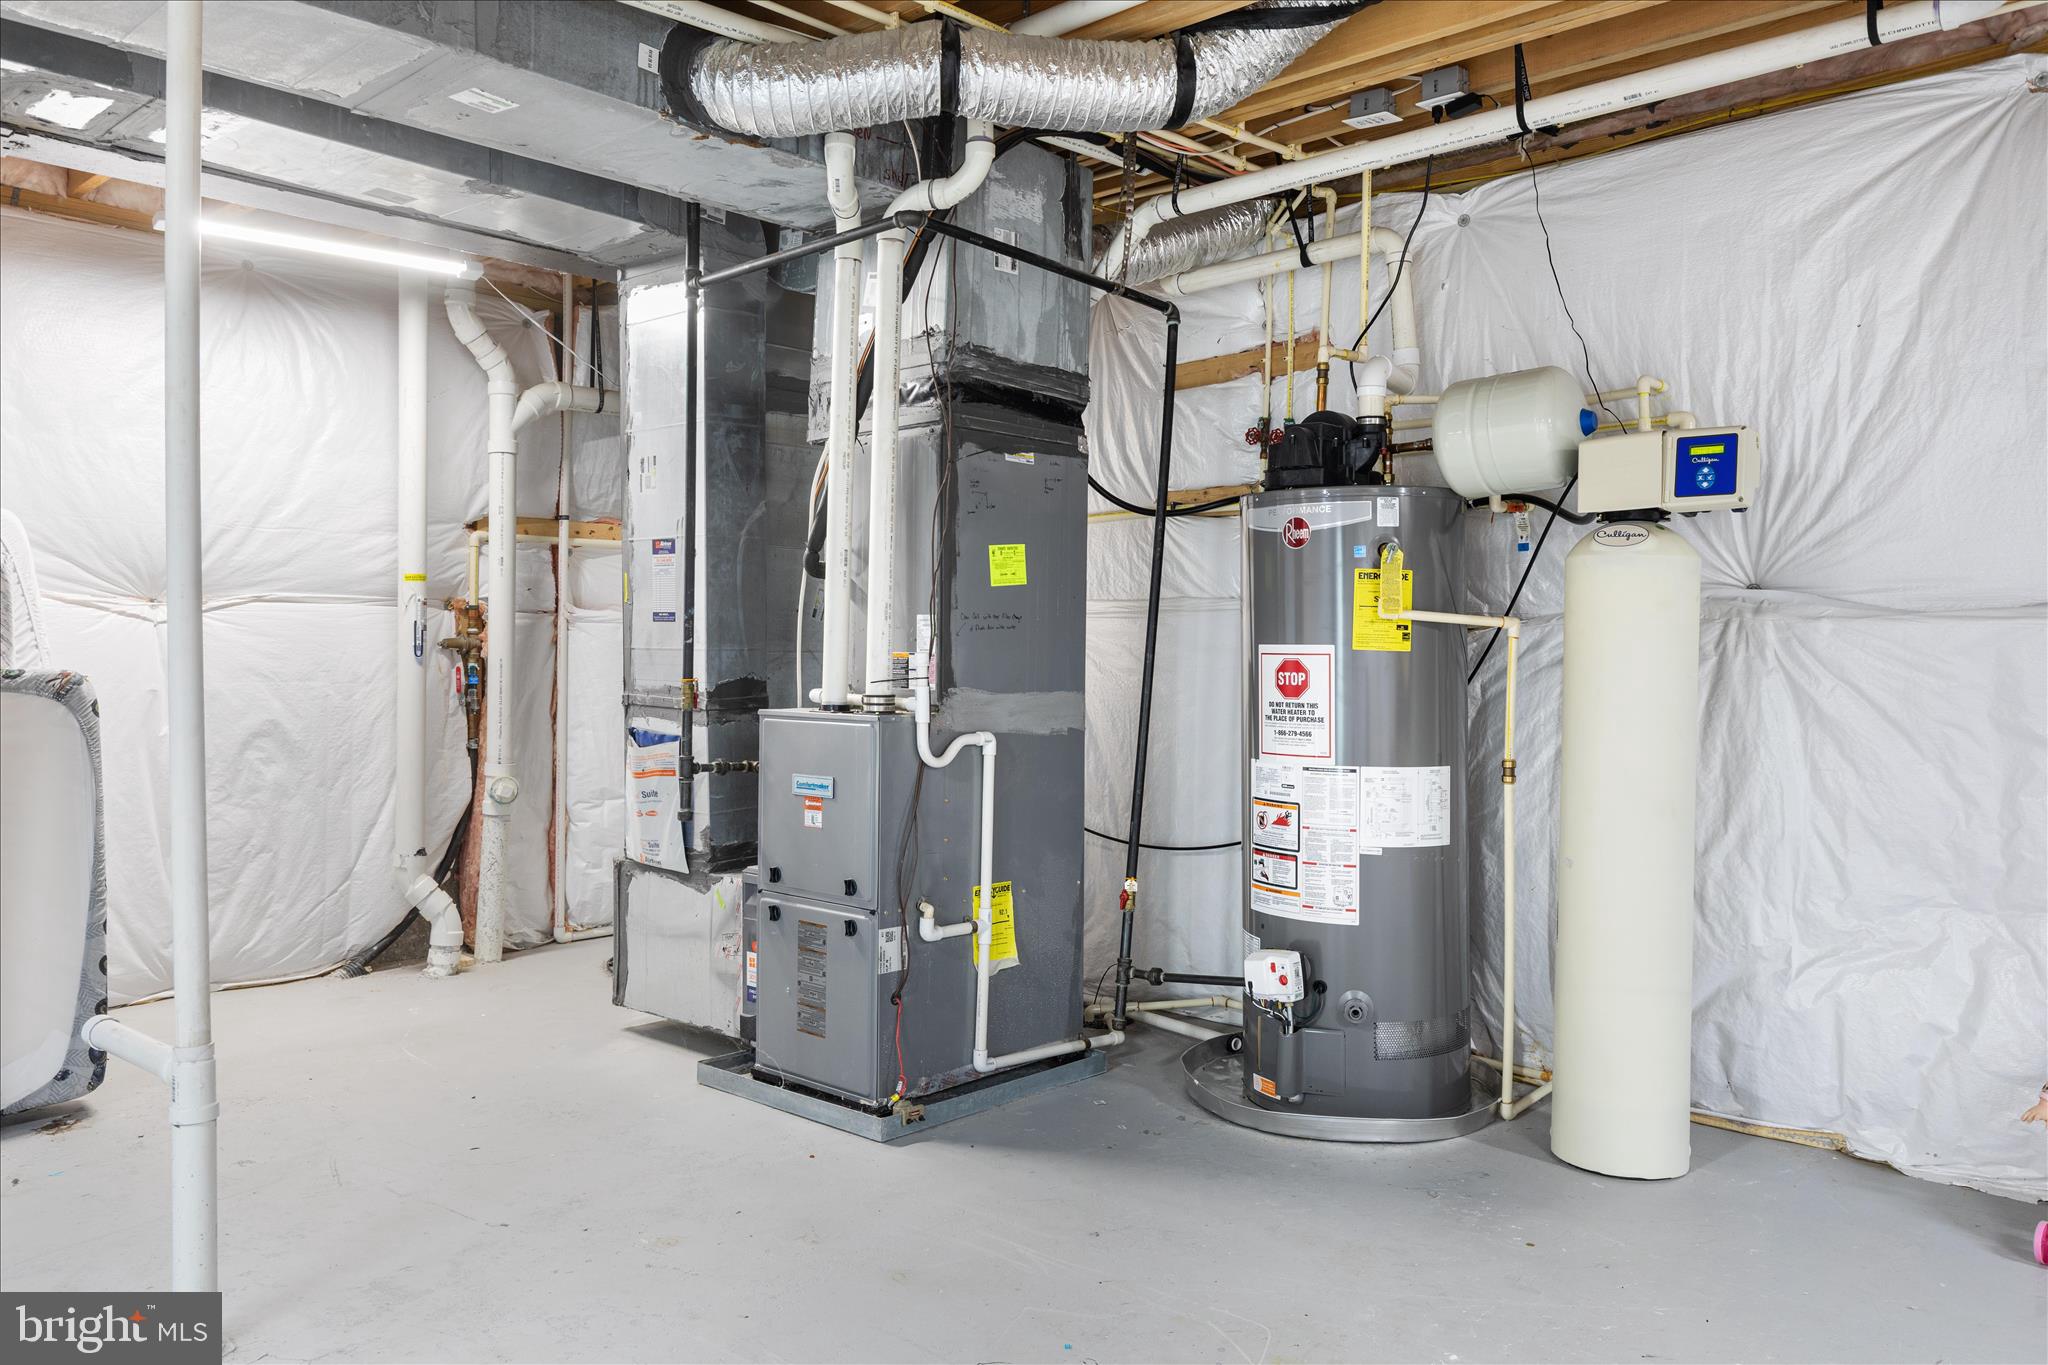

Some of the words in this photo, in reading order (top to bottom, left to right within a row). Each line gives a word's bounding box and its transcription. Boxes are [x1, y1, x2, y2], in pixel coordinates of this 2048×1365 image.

[1692, 456, 1719, 464] Culligan
[1284, 518, 1310, 544] Rheem
[1596, 529, 1647, 541] Culligan
[1278, 671, 1306, 686] STOP
[1287, 708, 1307, 716] HEATER
[795, 780, 830, 790] Comfortmaker
